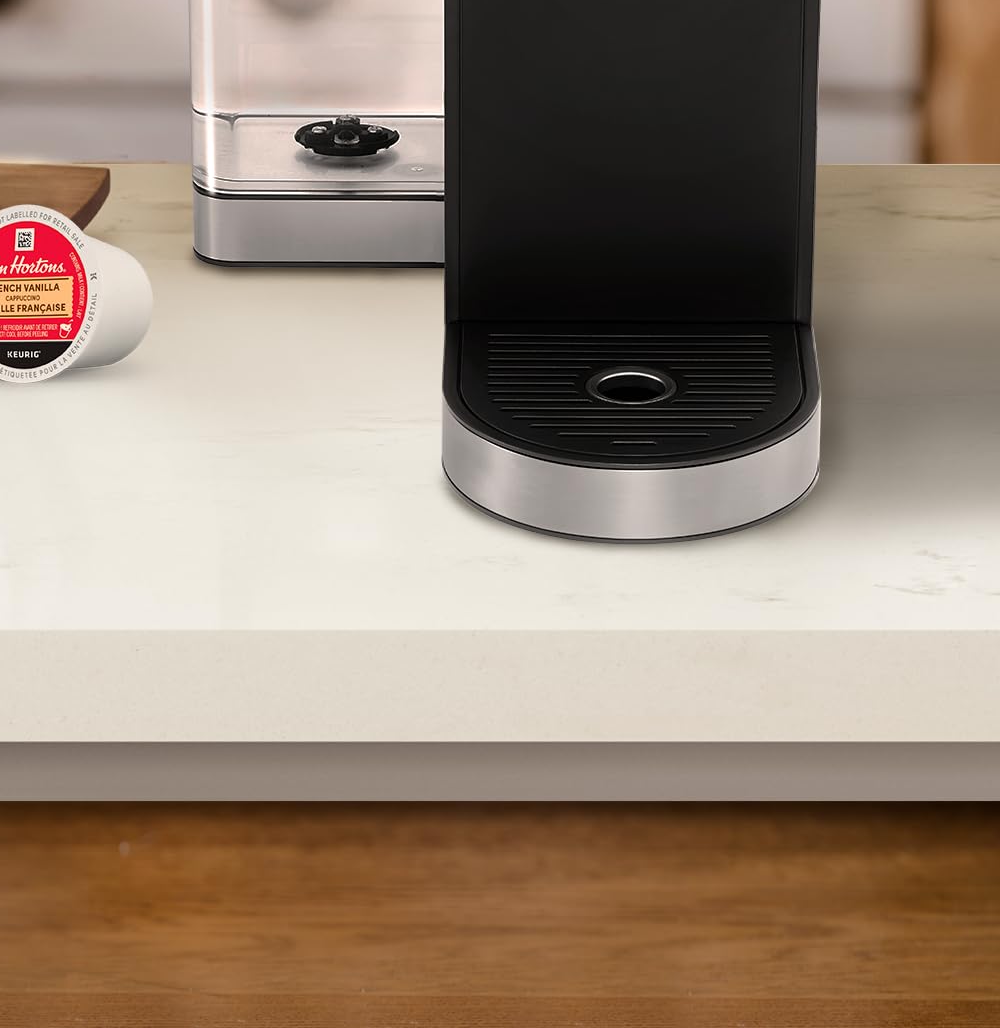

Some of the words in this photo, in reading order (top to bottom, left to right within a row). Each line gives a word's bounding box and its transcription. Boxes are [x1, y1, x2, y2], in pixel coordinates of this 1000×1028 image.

[6, 211, 38, 221] LABELLED
[39, 212, 53, 221] FOR
[53, 217, 72, 236] RETAIL
[71, 232, 85, 249] SALE
[24, 283, 60, 292] VANILLA
[17, 303, 66, 314] FRANÇAISE
[39, 364, 58, 375] POUR
[58, 357, 68, 366] LA
[67, 336, 86, 358] VENTE
[84, 324, 91, 335] AU
